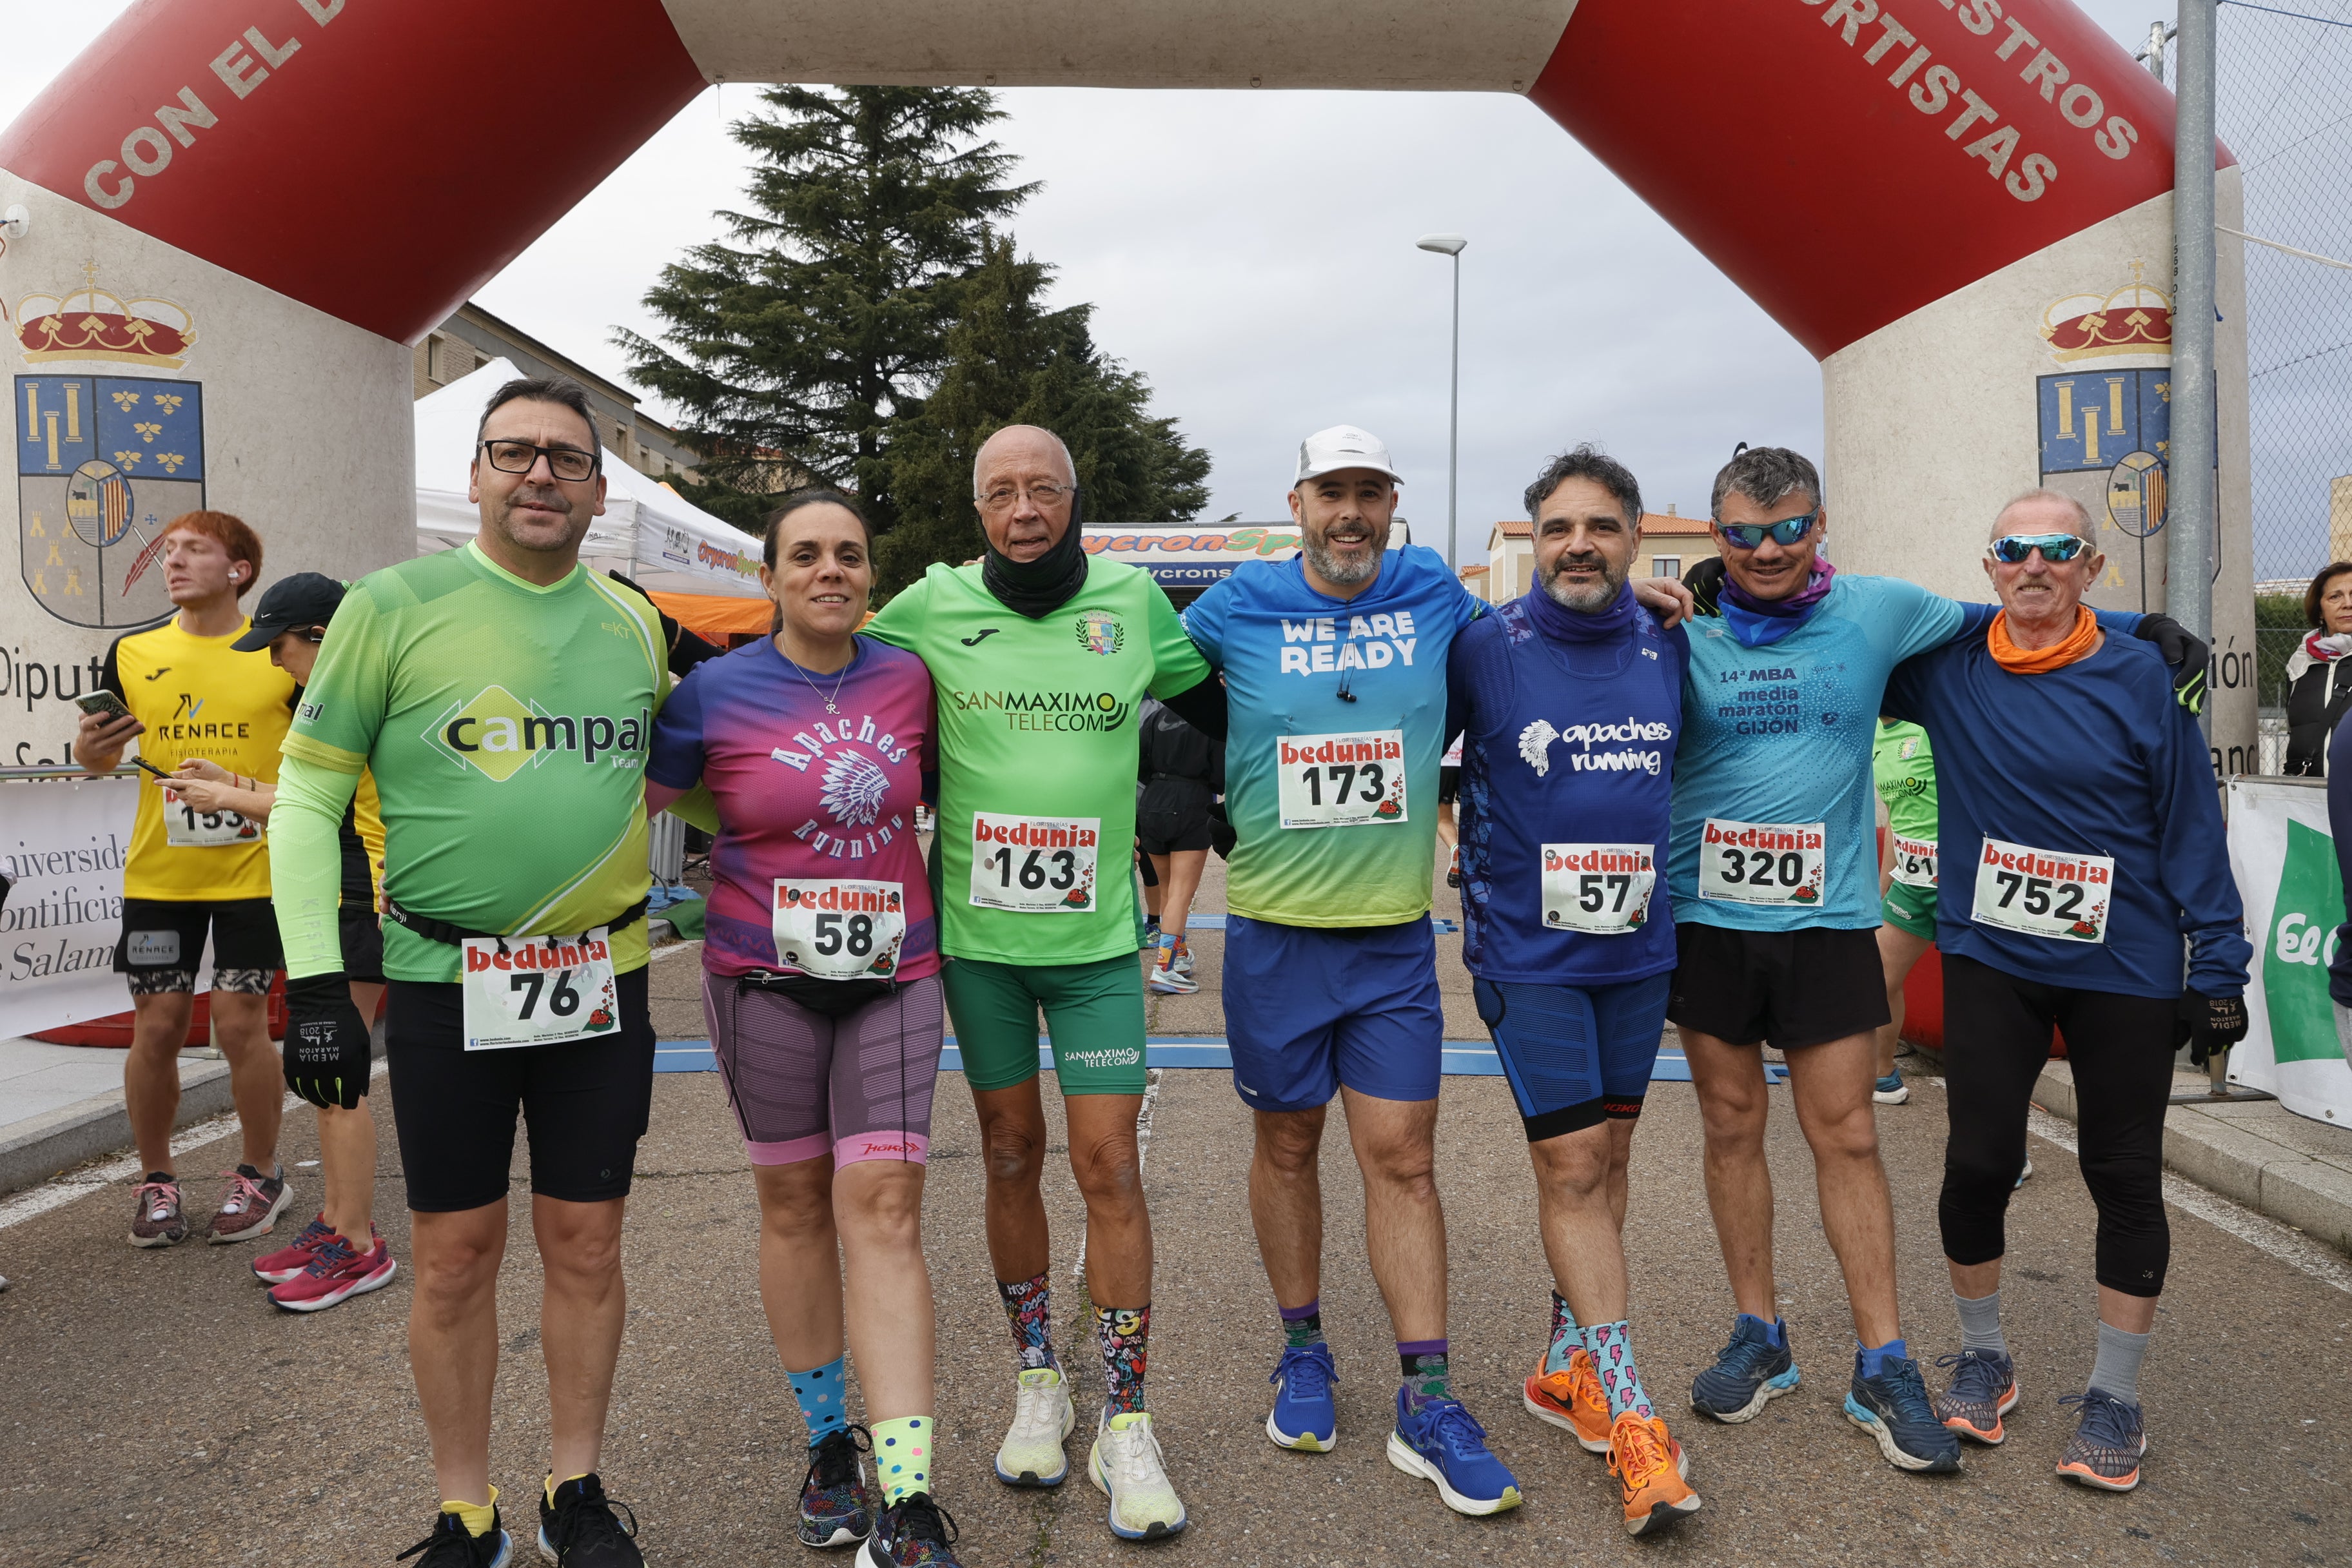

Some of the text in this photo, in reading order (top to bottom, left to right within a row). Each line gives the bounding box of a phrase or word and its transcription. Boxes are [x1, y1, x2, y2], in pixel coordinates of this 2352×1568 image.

[1943, 0, 2138, 160] STROS
[1805, 0, 2057, 202] RTISTAS
[84, 86, 219, 210] CON
[209, 25, 302, 100] EL
[1280, 611, 1415, 643] WE ARE
[1280, 638, 1417, 677] READY
[1749, 668, 1797, 681] MBA
[954, 691, 1116, 712] SANMAXIMO
[1738, 685, 1799, 701] media
[1004, 712, 1104, 732] TELECOM
[1718, 701, 1799, 717] maratón
[159, 723, 250, 741] RENACE
[447, 707, 648, 764] campal
[1562, 716, 1672, 751] apaches
[1736, 717, 1798, 735] GIJÓN
[170, 747, 239, 758] FISIOTERAPIA
[770, 715, 907, 773] Apaches
[1281, 738, 1400, 765] bedunia
[610, 754, 638, 769] Team
[1571, 748, 1661, 776] running
[1302, 763, 1386, 806] 173
[976, 819, 1096, 847] bedunia
[1705, 823, 1822, 850] bedunia
[995, 847, 1075, 890] 163
[1721, 848, 1803, 887] 320
[1983, 843, 2108, 885] bedunia
[1580, 875, 1631, 912] 57
[1997, 870, 2084, 921] 752
[815, 914, 872, 957] 58
[467, 940, 607, 972] bedunia
[511, 970, 580, 1020] 76
[300, 1026, 320, 1035] 2018
[2211, 1019, 2241, 1029] MEDIA
[299, 1053, 339, 1062] MEDIA
[1065, 1048, 1134, 1061] SANMAXIMO
[1084, 1057, 1131, 1068] TELECOM
